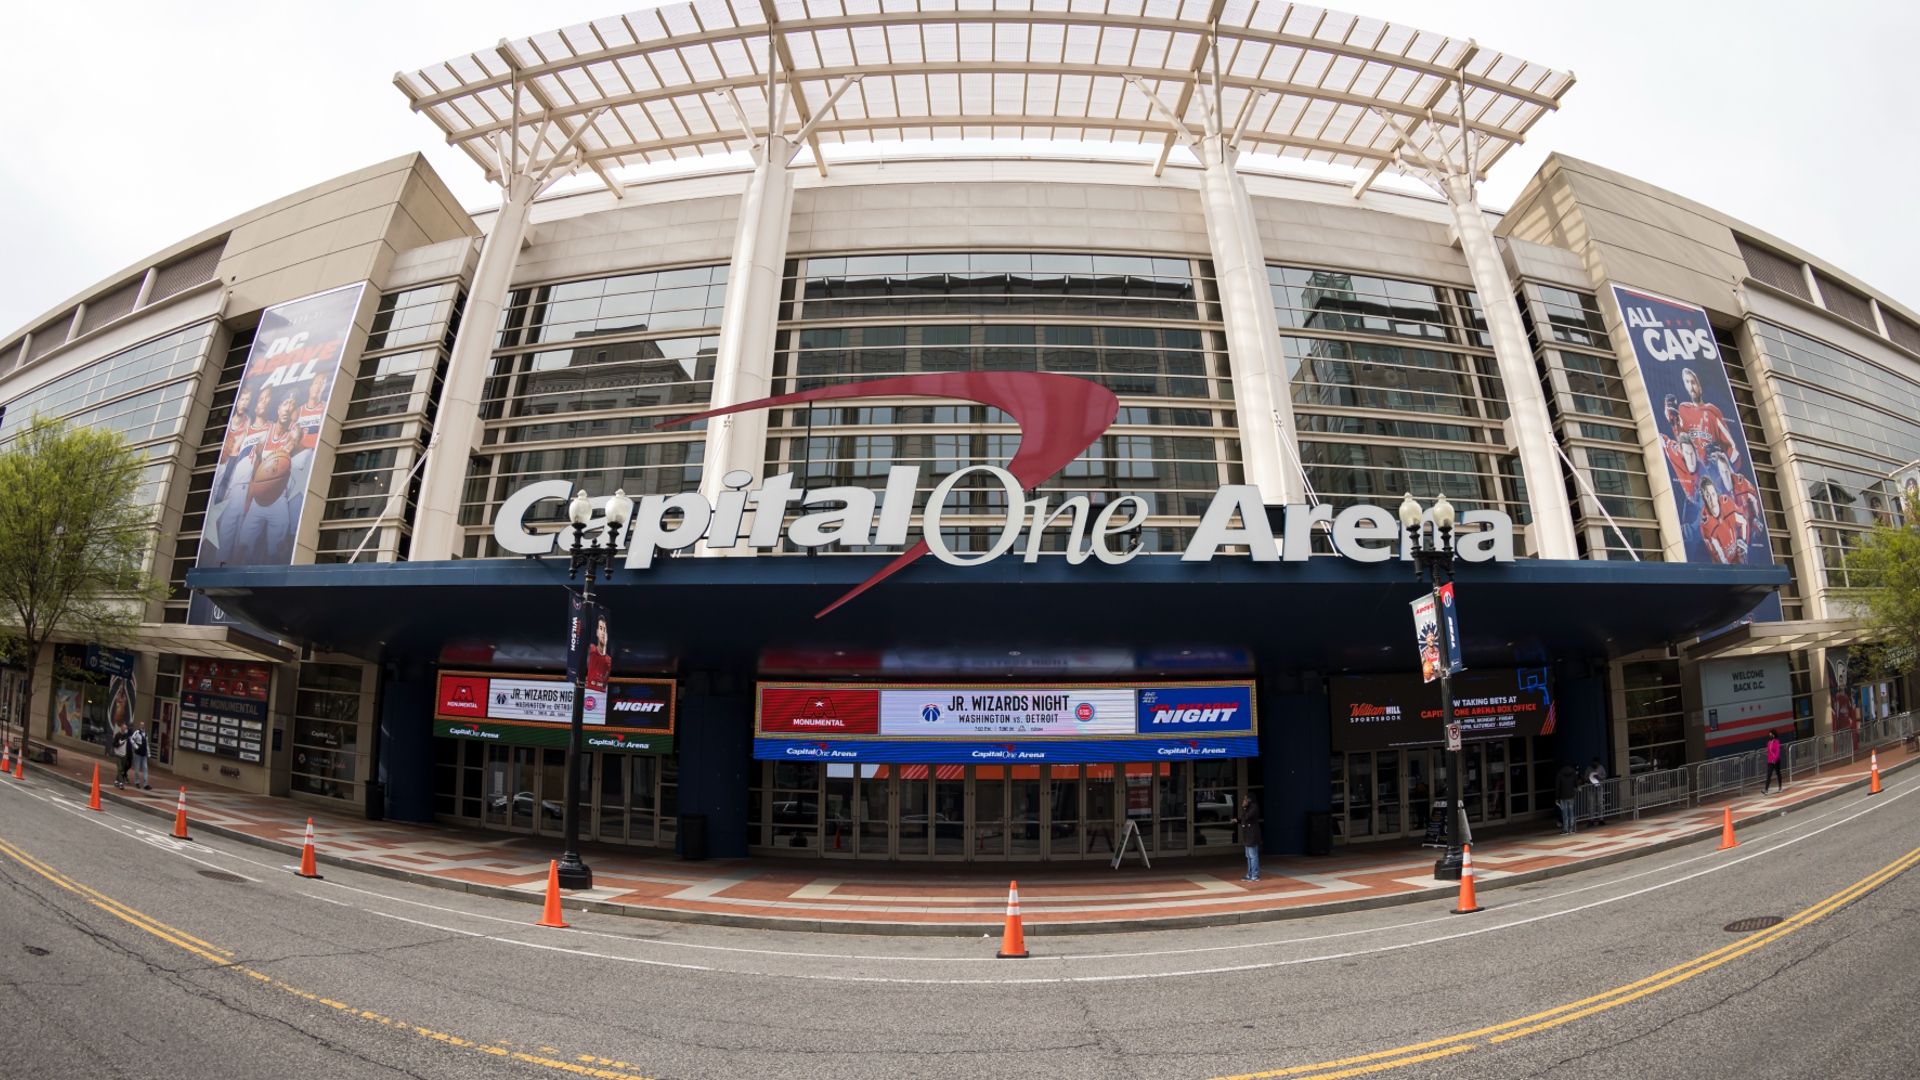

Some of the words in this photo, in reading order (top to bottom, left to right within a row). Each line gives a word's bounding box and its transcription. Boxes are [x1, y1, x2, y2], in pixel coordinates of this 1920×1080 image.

[1627, 306, 1664, 328] ALL
[264, 331, 310, 360] DC
[1642, 328, 1718, 362] CAPS
[260, 358, 319, 390] ALL
[570, 617, 578, 652] WILSON
[1732, 669, 1764, 680] WELCOME
[1734, 682, 1752, 692] BACK
[510, 688, 522, 700] JR.
[524, 689, 558, 702] WIZARDS
[560, 691, 573, 702] NIG
[613, 702, 664, 712] NIGHT
[948, 696, 968, 711] JR.
[972, 696, 1028, 711] WIZARDS
[1032, 695, 1070, 711] NIGHT
[1462, 698, 1488, 706] TAKING
[1350, 703, 1386, 716] William
[1386, 706, 1401, 714] HILL
[1421, 710, 1444, 718] CAPIT
[1472, 707, 1496, 715] ARENA
[959, 714, 1010, 723] WASHINGTON
[1026, 714, 1058, 723] DETROIT
[1153, 708, 1238, 724] NIGHT
[1350, 715, 1401, 723] SPORTSBOOK
[480, 731, 499, 739] Arena
[626, 741, 650, 749] Arena
